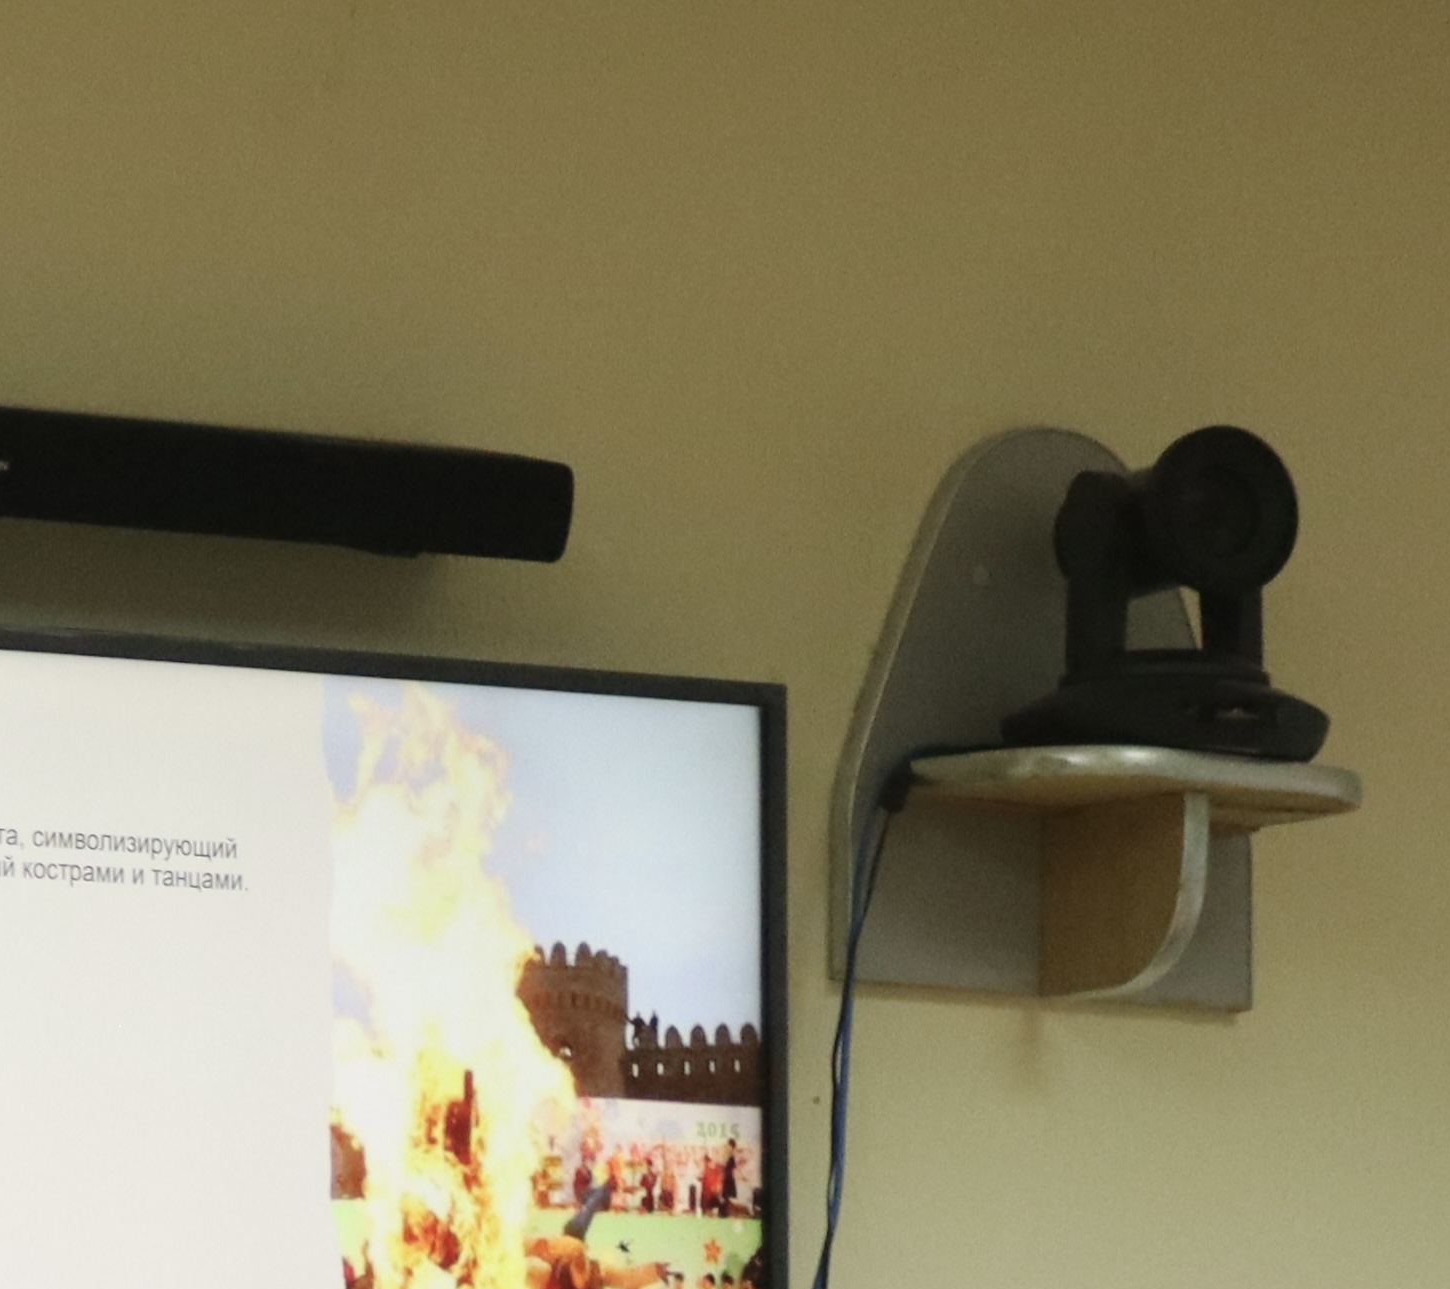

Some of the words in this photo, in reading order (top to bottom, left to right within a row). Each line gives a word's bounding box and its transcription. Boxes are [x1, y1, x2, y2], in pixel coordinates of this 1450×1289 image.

[31, 829, 238, 862] символизирующий
[22, 861, 125, 887] кострами
[131, 868, 145, 885] и
[151, 868, 250, 893] танцами.
